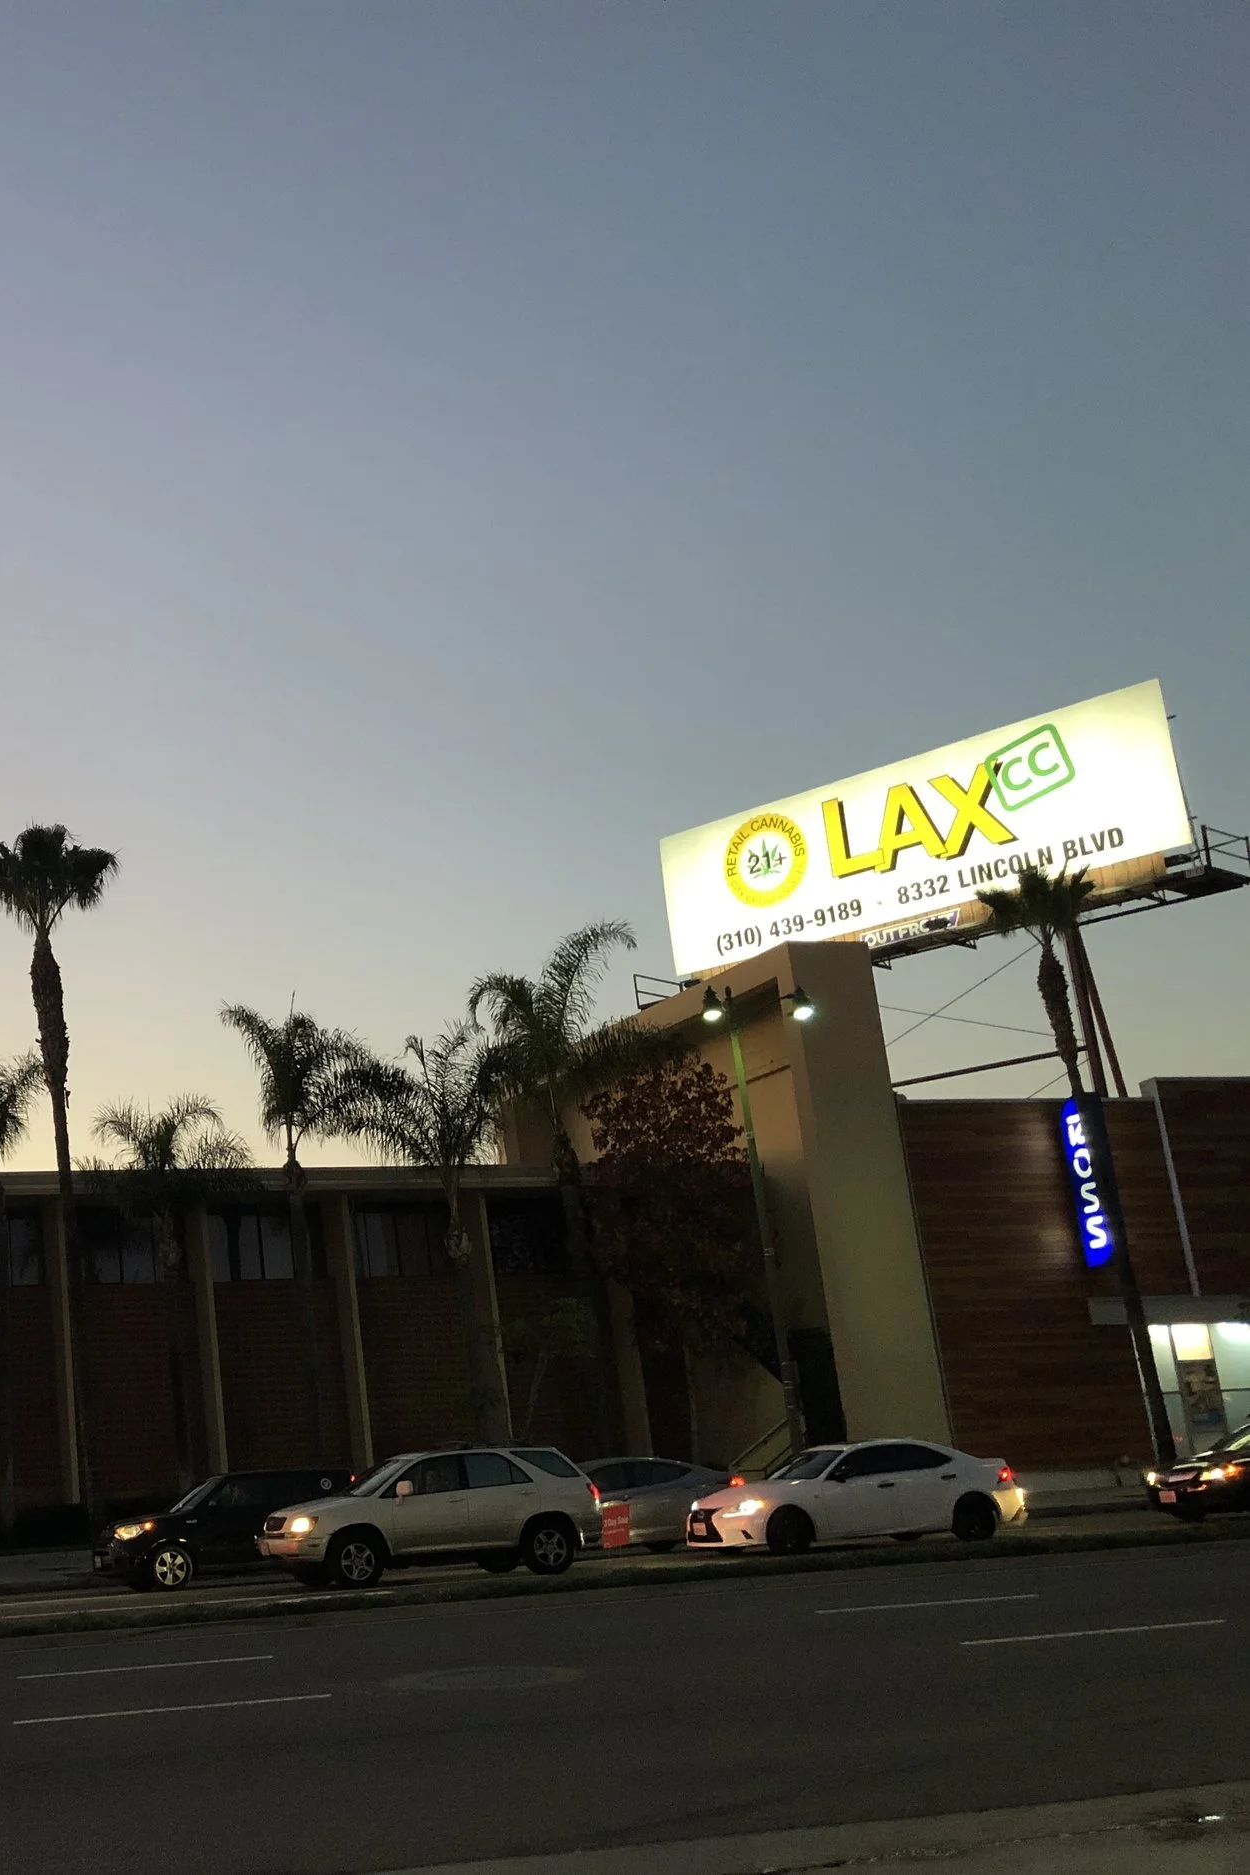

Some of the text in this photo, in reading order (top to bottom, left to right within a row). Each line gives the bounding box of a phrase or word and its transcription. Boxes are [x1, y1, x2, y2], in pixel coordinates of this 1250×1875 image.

[727, 817, 805, 877] RETAIL CANNABIS
[821, 741, 1060, 879] LAX CC
[716, 827, 1125, 956] (310) 439-9189 8332 LINCOLN BLVD
[748, 850, 787, 874] 21+
[864, 911, 955, 947] OUTFRO
[1065, 1113, 1108, 1249] ROSS
